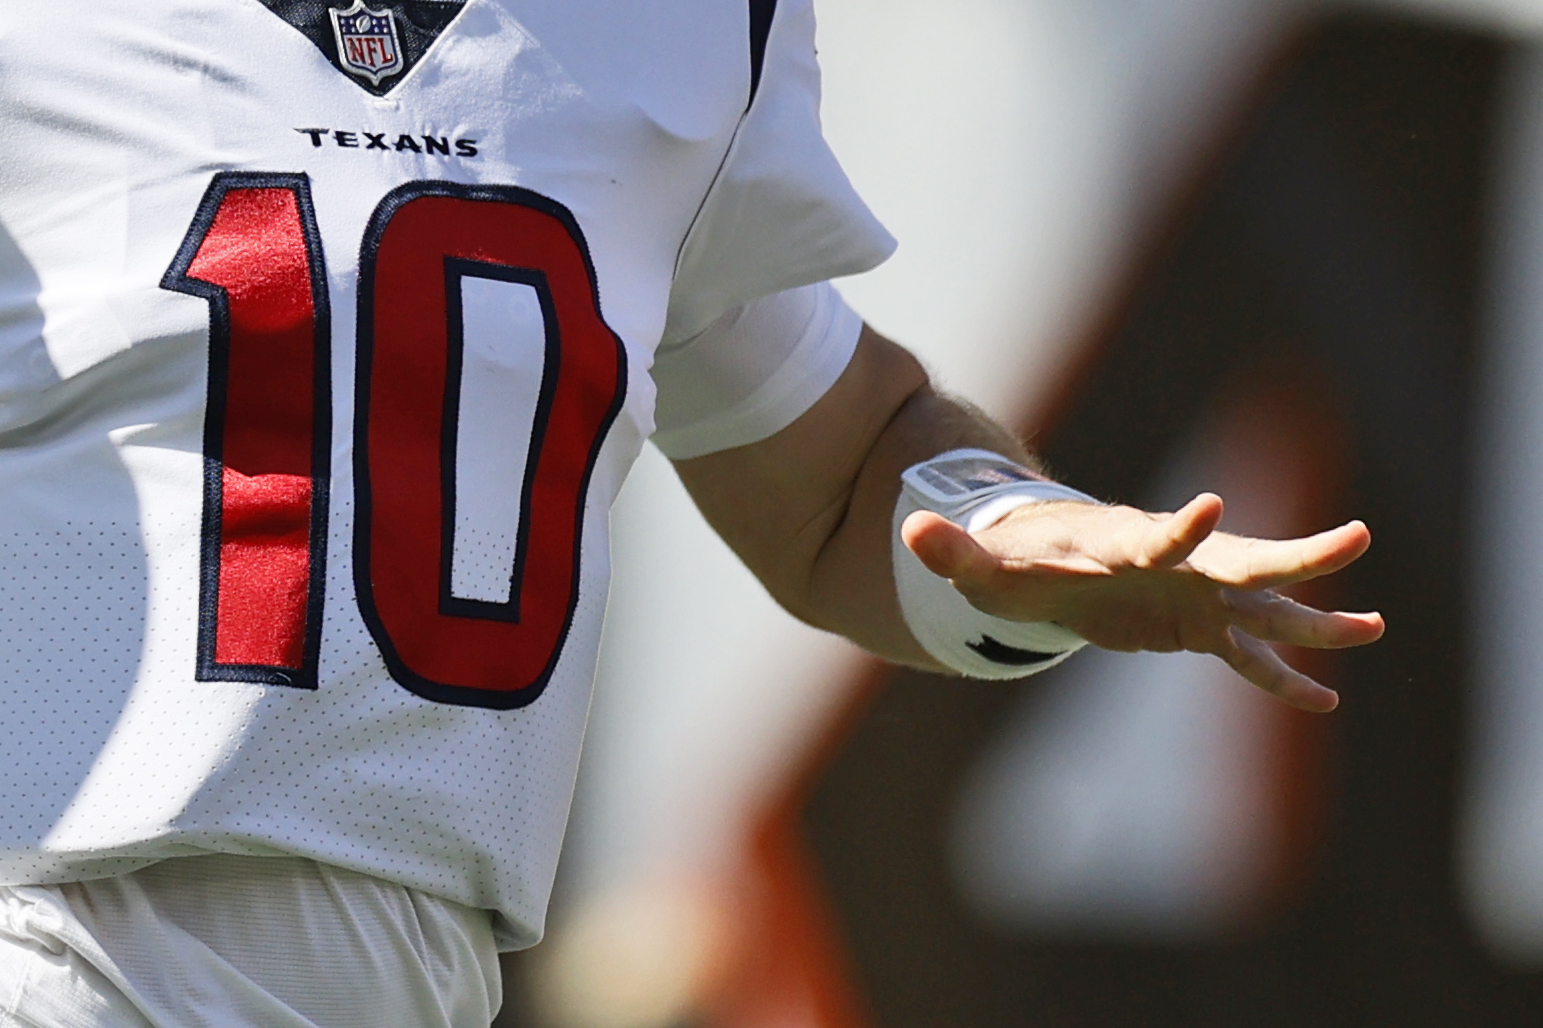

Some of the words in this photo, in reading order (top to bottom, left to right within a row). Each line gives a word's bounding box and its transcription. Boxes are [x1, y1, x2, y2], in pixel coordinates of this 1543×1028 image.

[346, 36, 394, 68] NFL
[293, 127, 479, 158] TEXANS
[159, 171, 629, 711] 10
